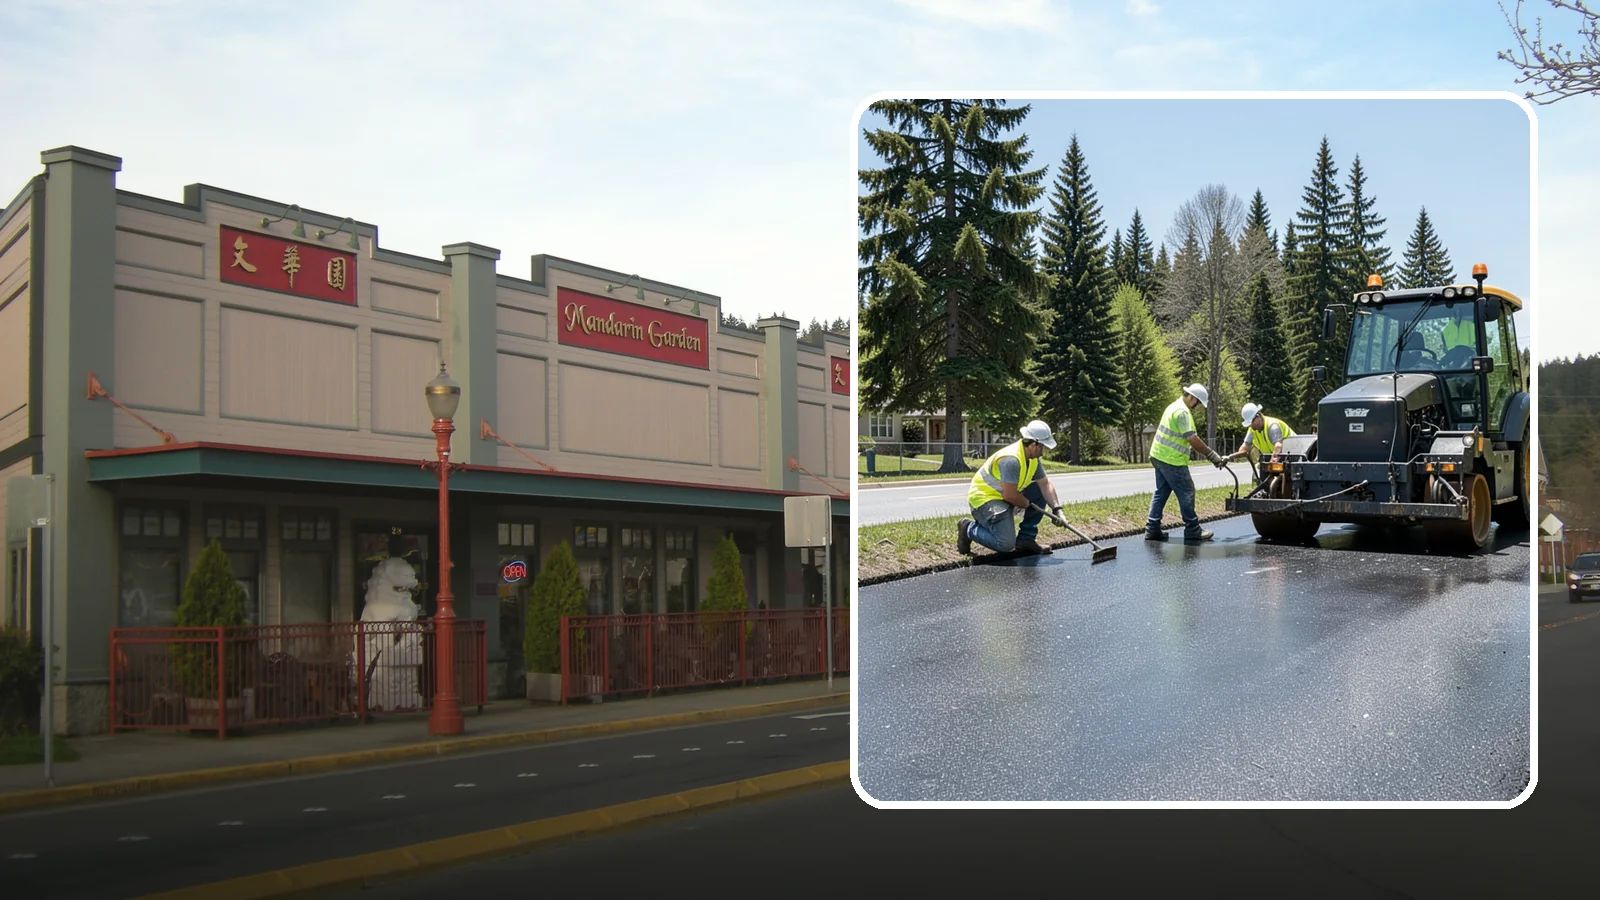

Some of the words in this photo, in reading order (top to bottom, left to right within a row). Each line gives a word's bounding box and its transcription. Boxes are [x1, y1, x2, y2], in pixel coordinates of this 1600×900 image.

[231, 236, 346, 290] 文華園
[565, 302, 644, 341] Mandarin
[648, 320, 701, 352] Garden
[835, 363, 846, 386] 文
[503, 565, 527, 578] OPEN
